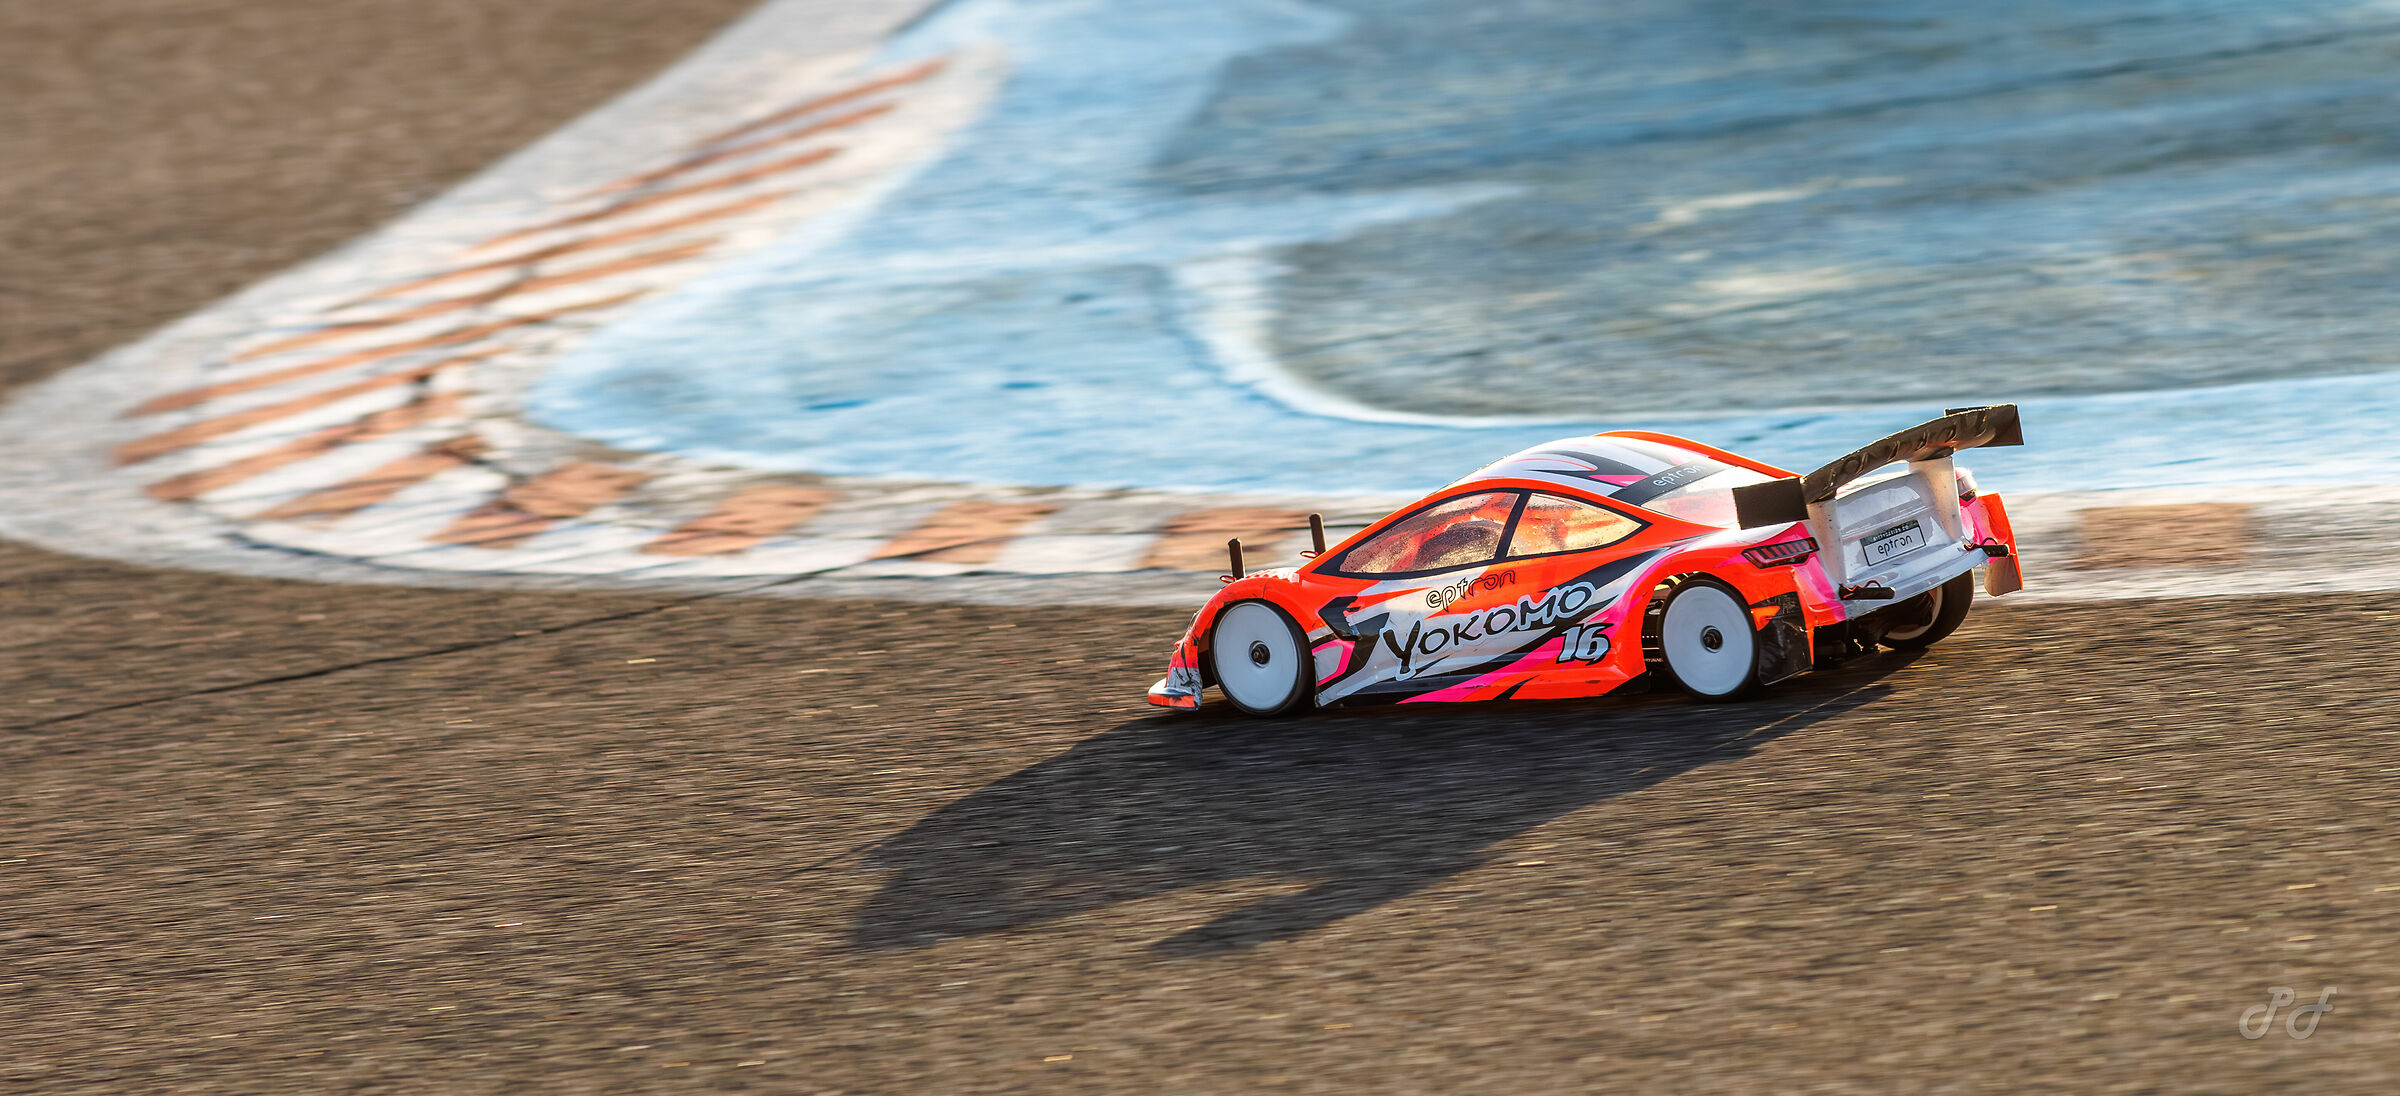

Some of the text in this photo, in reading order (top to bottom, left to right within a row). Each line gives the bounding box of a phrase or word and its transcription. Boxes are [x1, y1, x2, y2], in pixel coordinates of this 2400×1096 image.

[1653, 465, 1705, 486] eptron
[1877, 534, 1913, 556] eptron
[1426, 570, 1516, 612] eptron
[1380, 582, 1596, 681] YOKOMO
[1556, 622, 1614, 666] 16
